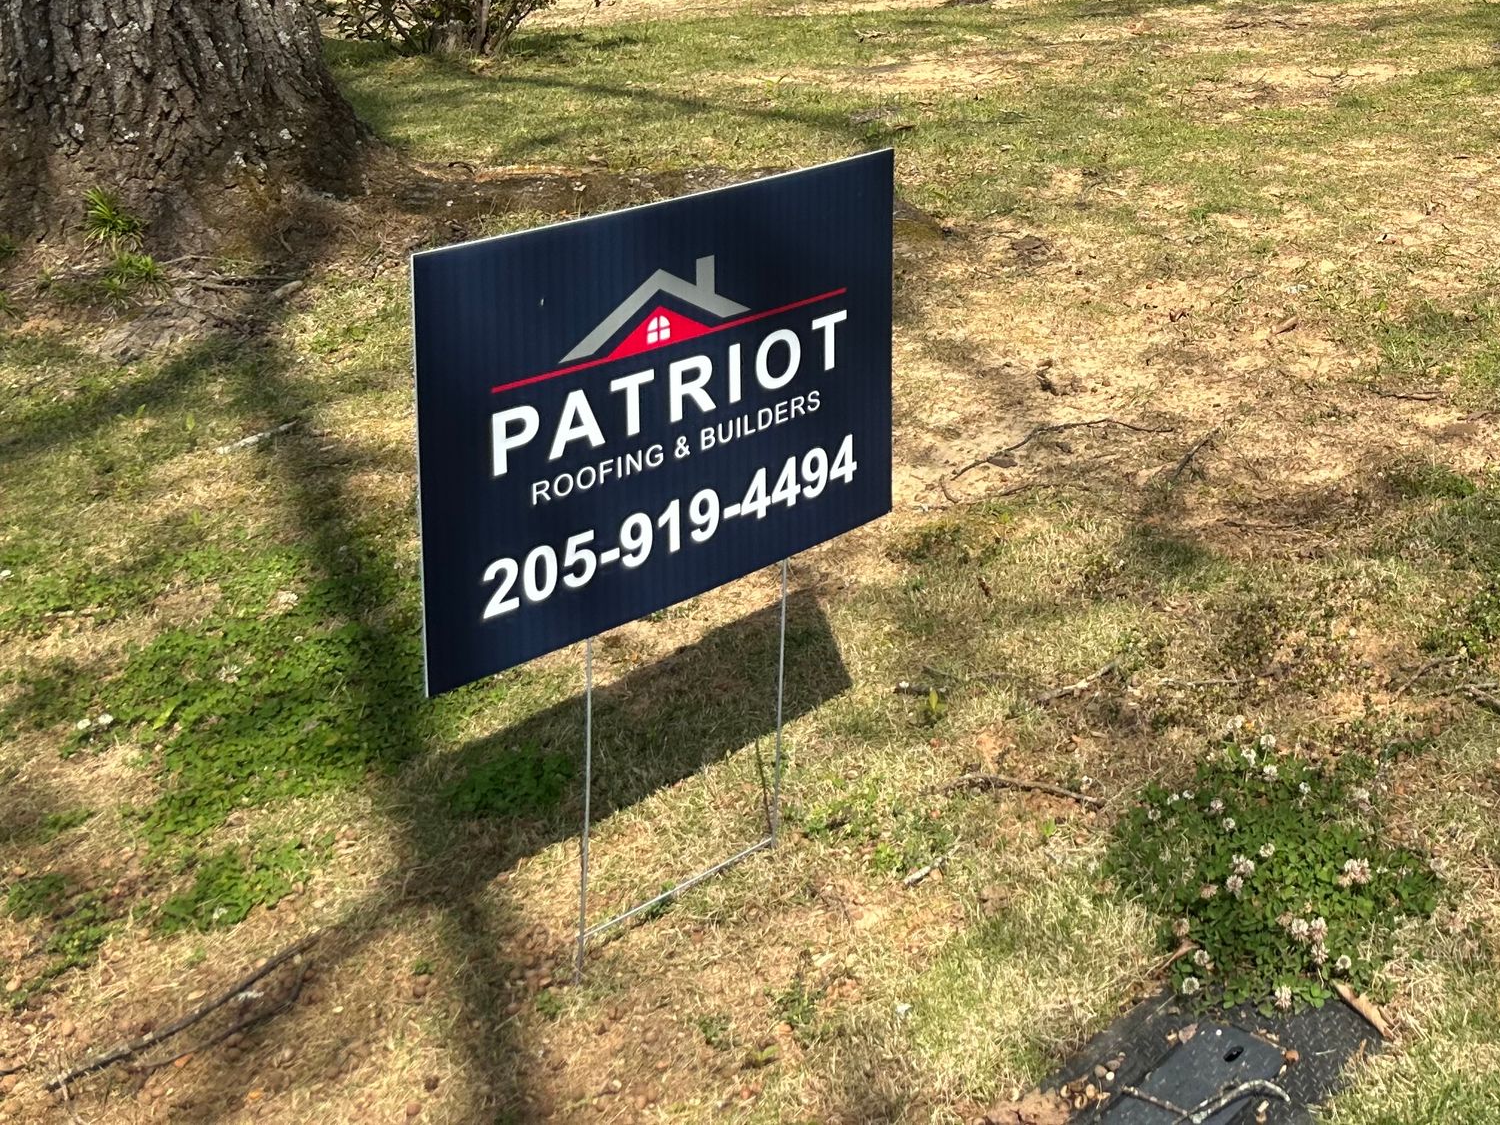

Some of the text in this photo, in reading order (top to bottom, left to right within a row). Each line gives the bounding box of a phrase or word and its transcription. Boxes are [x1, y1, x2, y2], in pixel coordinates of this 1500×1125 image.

[491, 309, 848, 477] PATRIOT
[531, 390, 822, 506] ROOFING & BUILDERS
[482, 433, 858, 620] 205-919-4494
